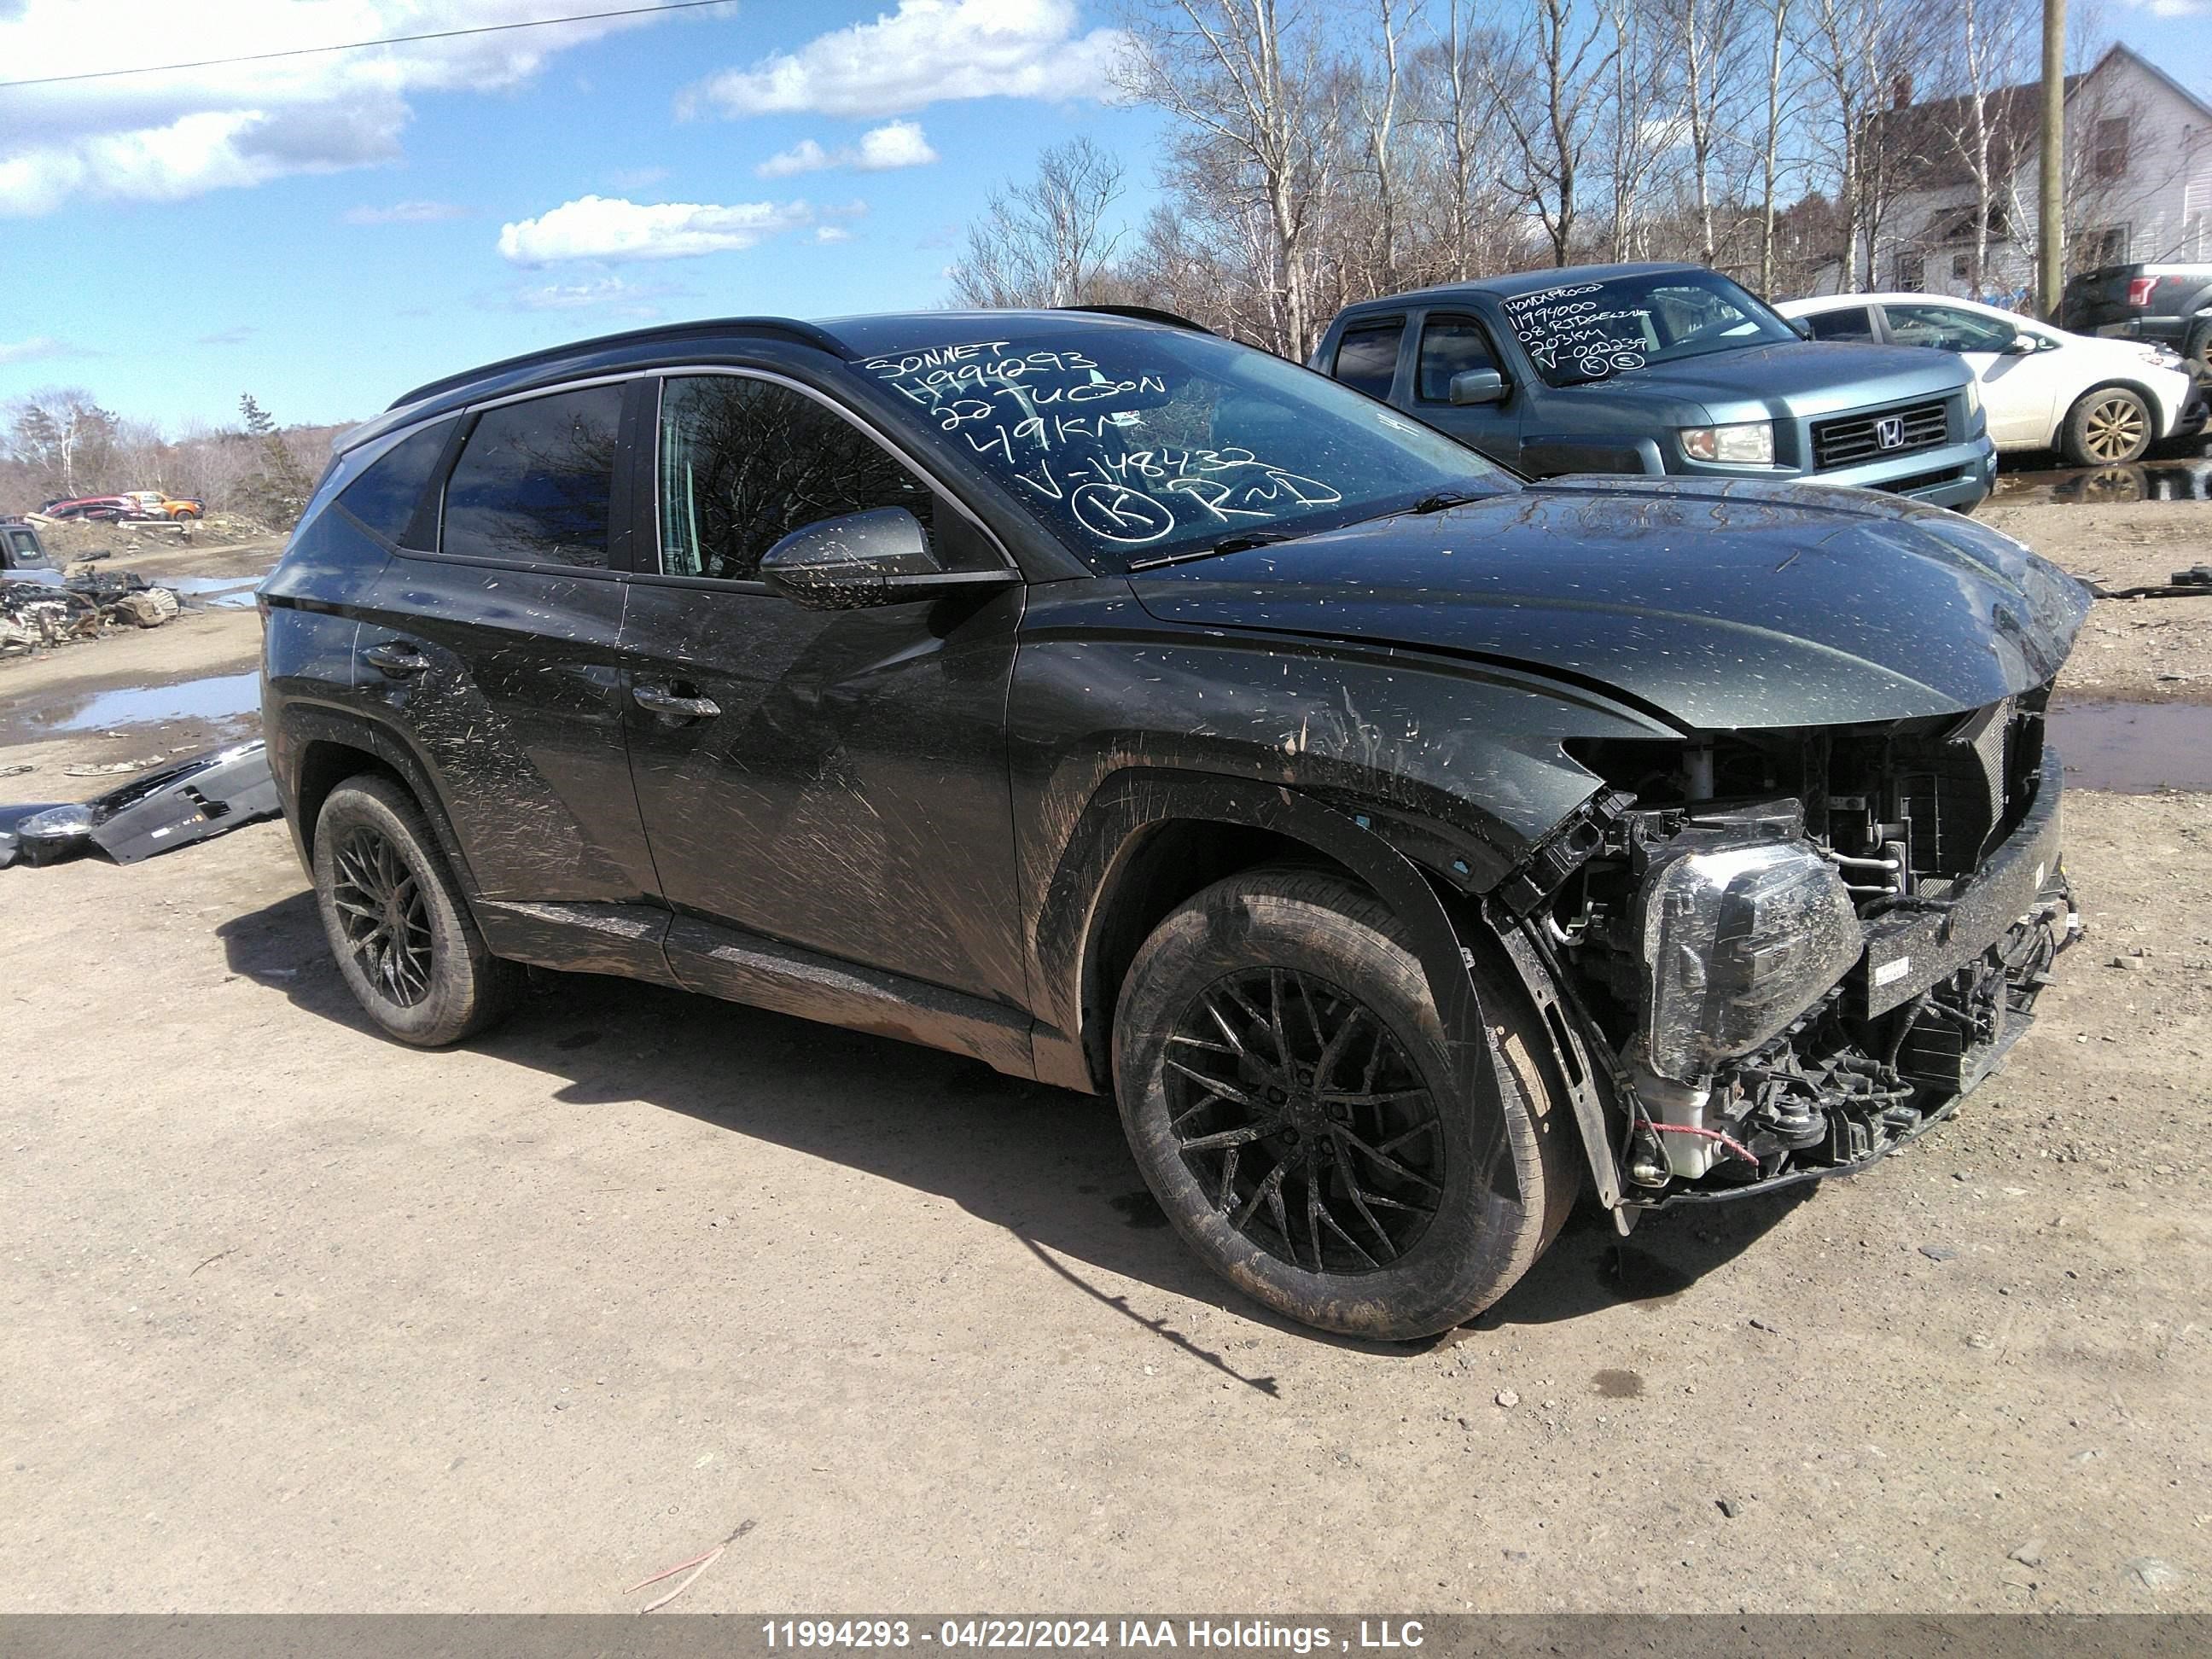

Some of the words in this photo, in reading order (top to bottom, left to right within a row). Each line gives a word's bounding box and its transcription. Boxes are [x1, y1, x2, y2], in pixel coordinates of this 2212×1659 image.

[1508, 301, 1598, 331] 11994000
[1518, 325, 1545, 342] 08
[865, 341, 1010, 379] SONNET
[892, 352, 1098, 405] 11994293
[930, 399, 997, 431] 22
[992, 375, 1166, 409] TUCSON
